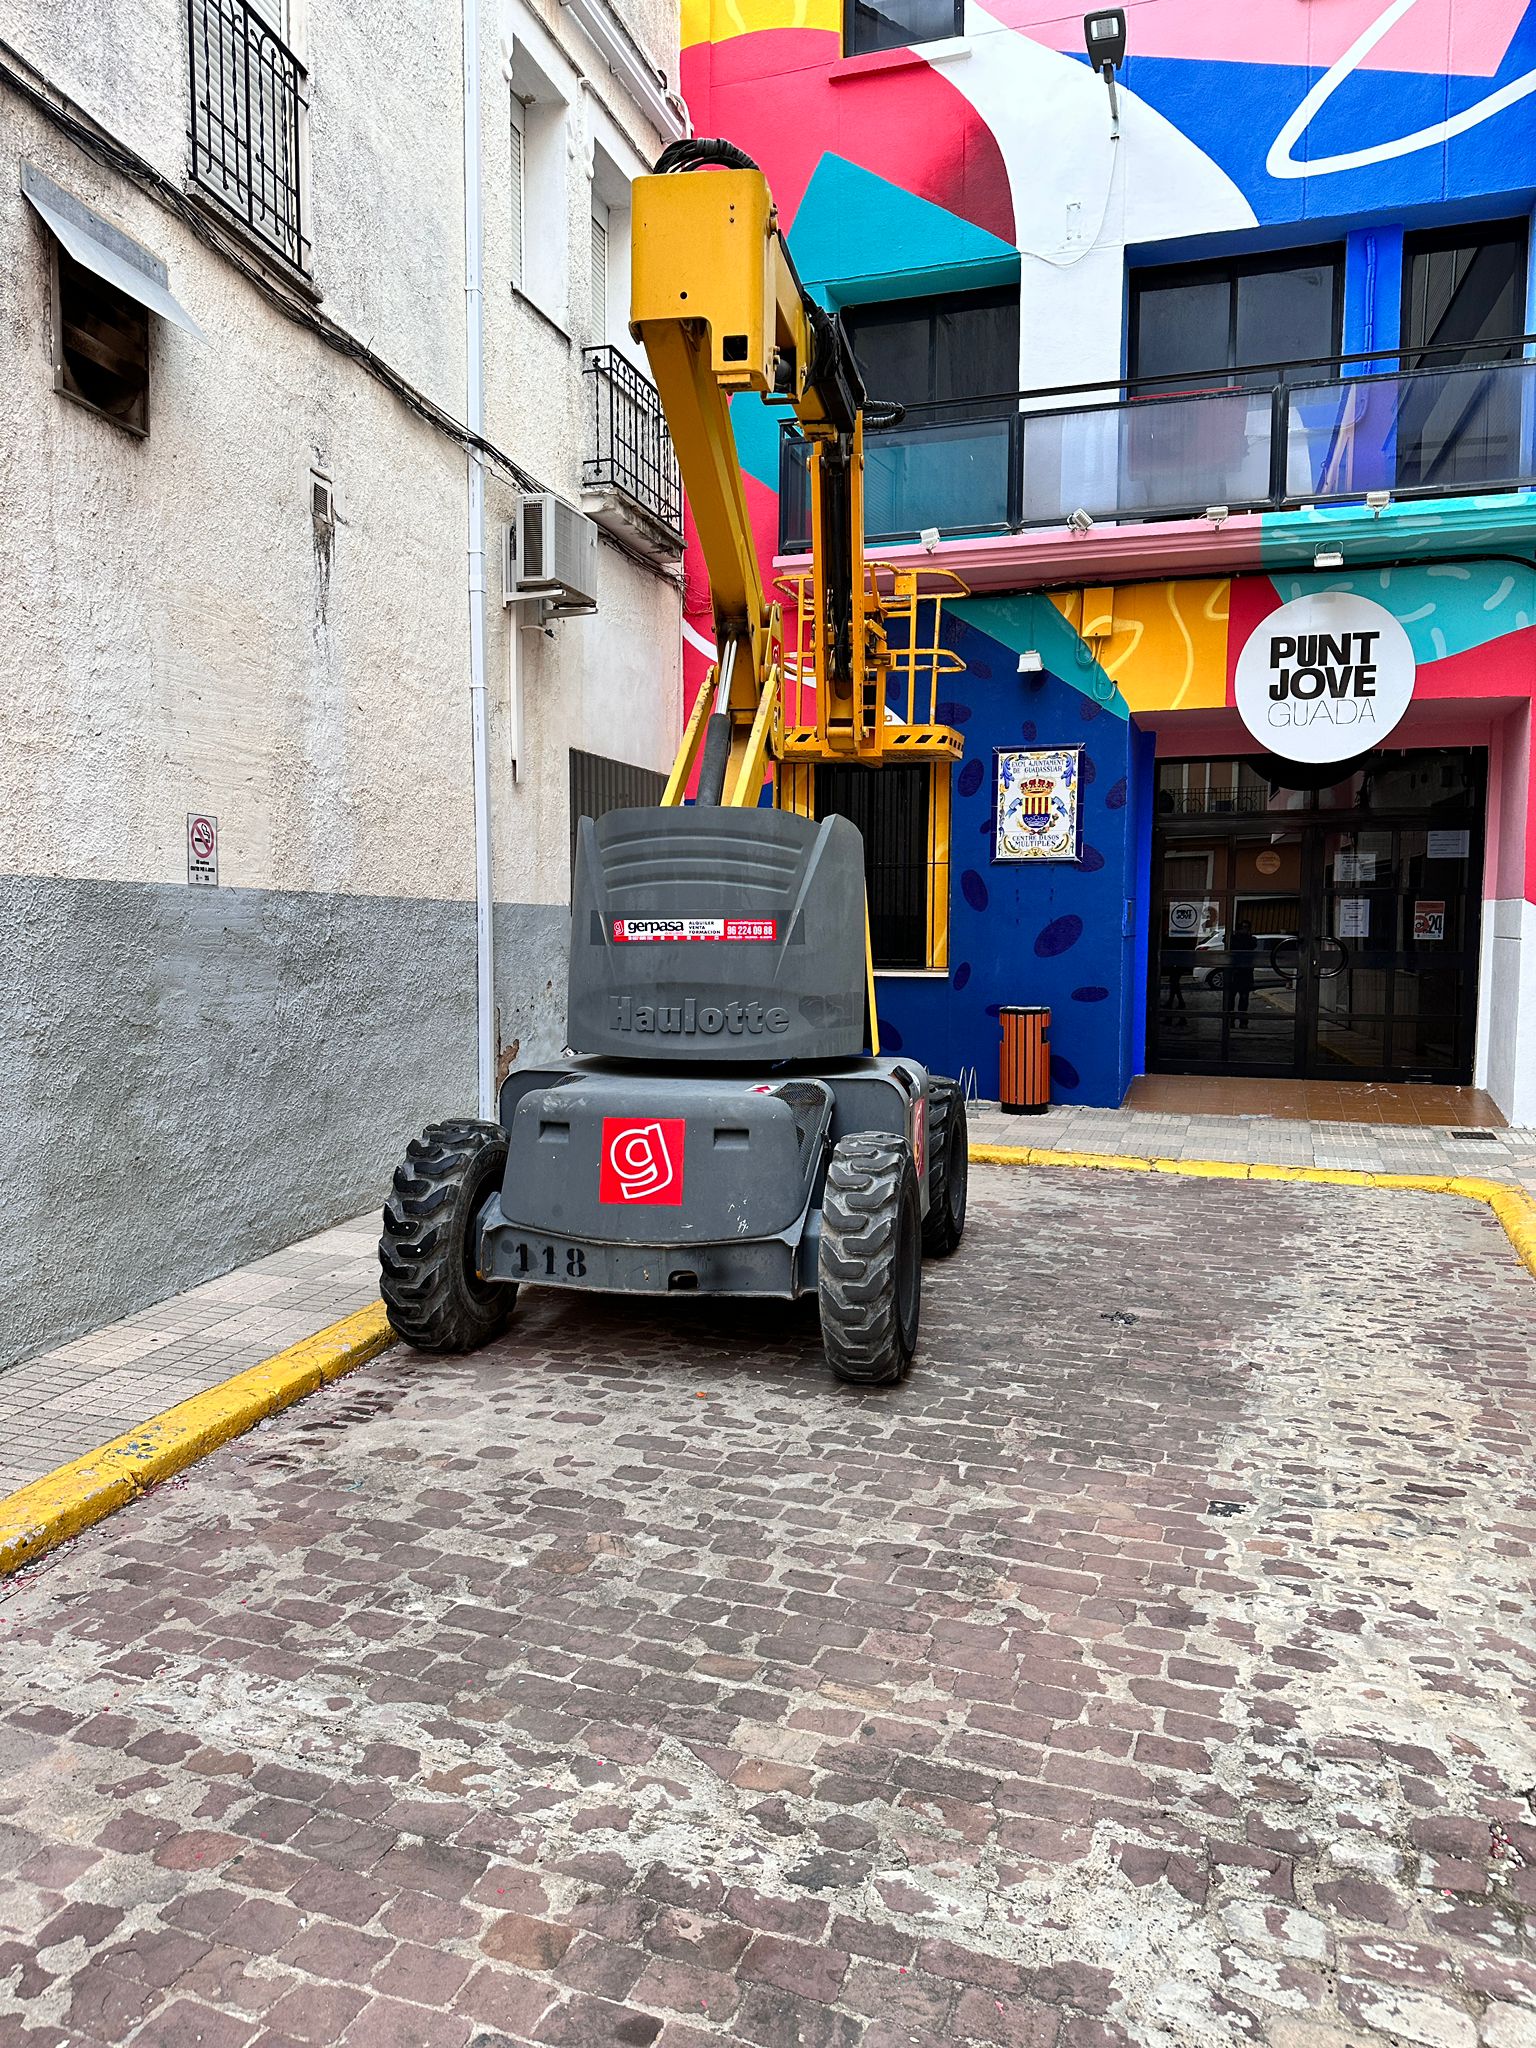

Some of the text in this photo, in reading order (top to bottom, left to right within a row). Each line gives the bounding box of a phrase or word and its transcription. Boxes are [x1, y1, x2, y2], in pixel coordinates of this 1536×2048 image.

[1270, 631, 1380, 669] PUNT
[1269, 665, 1377, 701] JOVE
[1267, 698, 1376, 727] GUADA
[1028, 759, 1064, 767] AJUNTAMENT
[627, 921, 684, 934] gerpasa
[738, 925, 752, 935] 224
[608, 995, 790, 1034] Haulotte
[610, 1122, 674, 1200] g
[515, 1243, 588, 1278] 118
